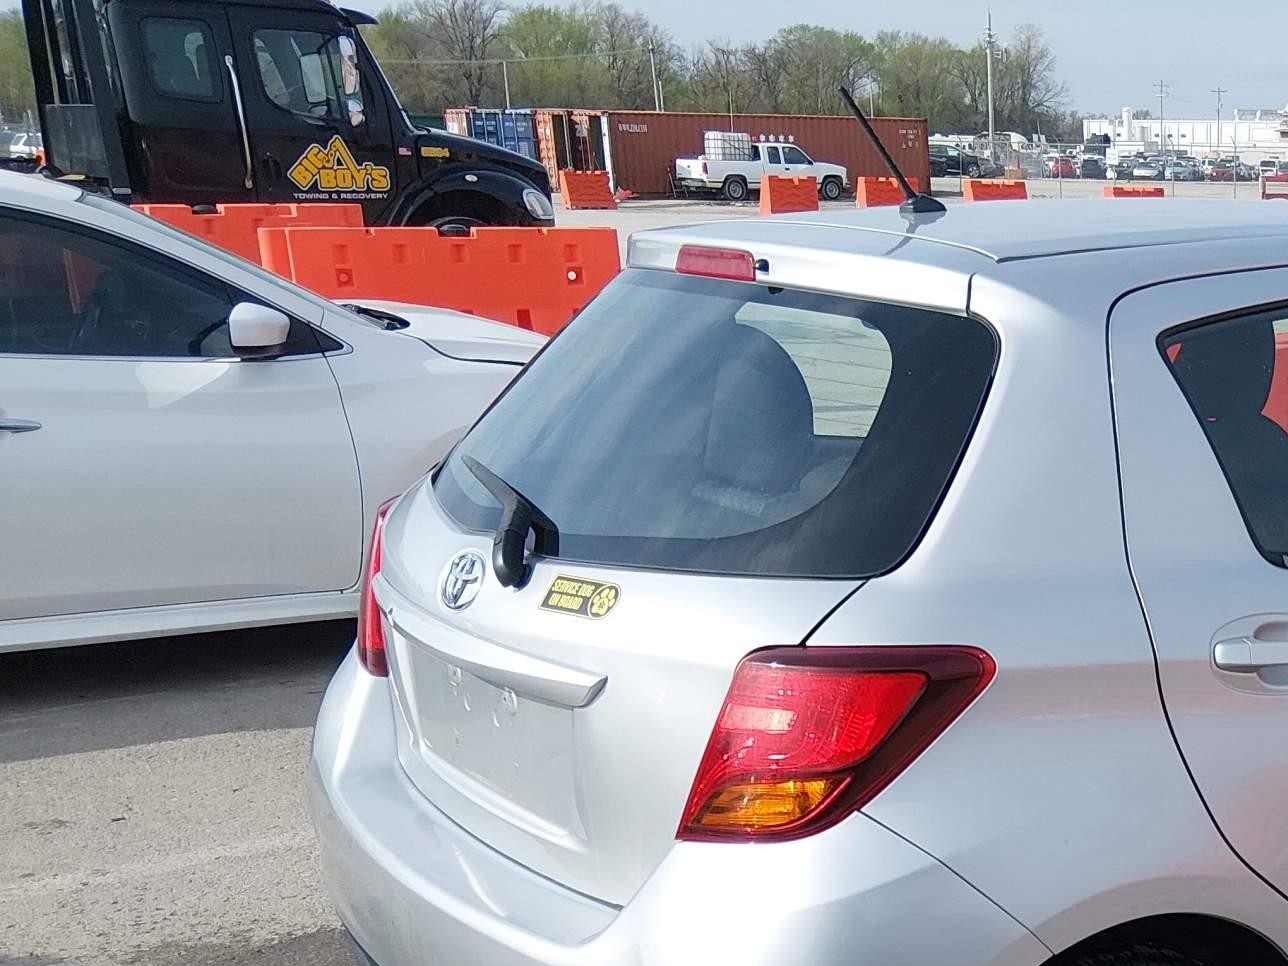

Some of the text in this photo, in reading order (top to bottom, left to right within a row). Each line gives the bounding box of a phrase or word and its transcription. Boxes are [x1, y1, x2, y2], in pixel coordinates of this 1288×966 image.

[289, 145, 328, 188] BIG
[552, 579, 596, 598] SERVICE DOG
[548, 592, 583, 611] ON BOARD
